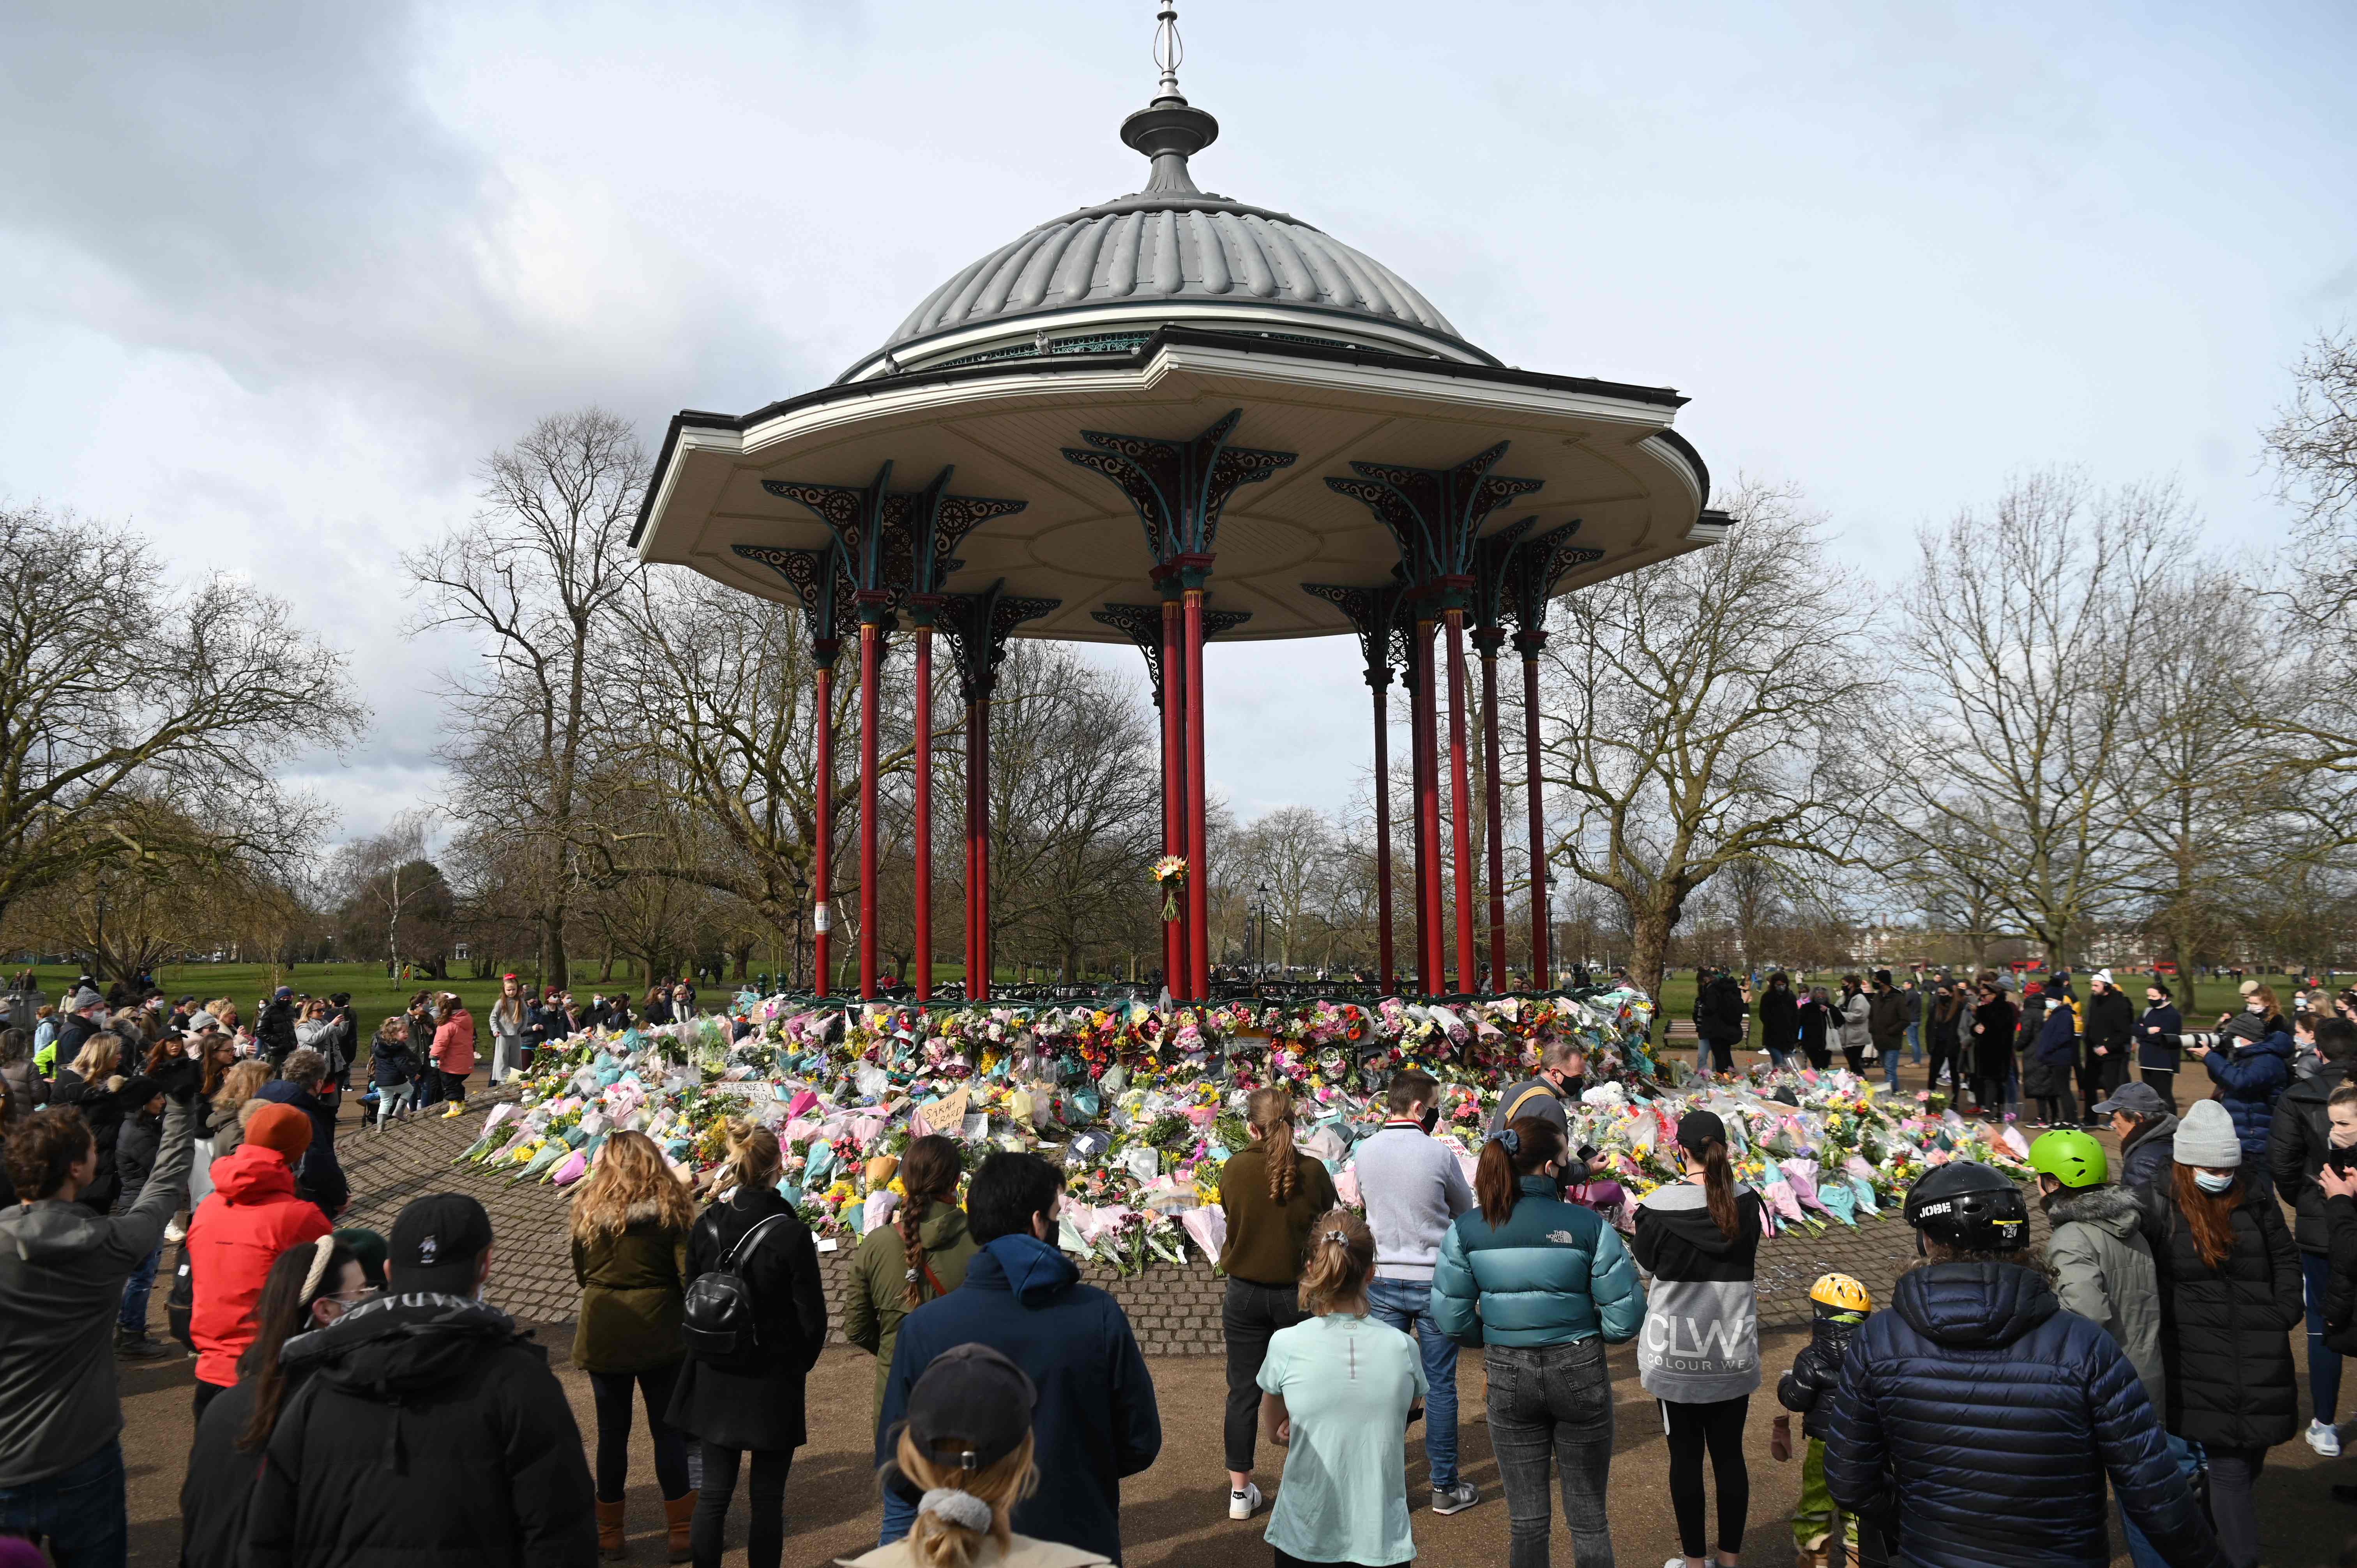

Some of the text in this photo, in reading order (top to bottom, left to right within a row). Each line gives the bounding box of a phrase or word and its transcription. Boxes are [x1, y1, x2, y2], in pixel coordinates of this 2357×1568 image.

[925, 1097, 956, 1119] SARAH
[928, 1106, 962, 1126] VERARD
[1919, 1202, 1952, 1218] JOBE
[1647, 1353, 1712, 1370] COLOUR
